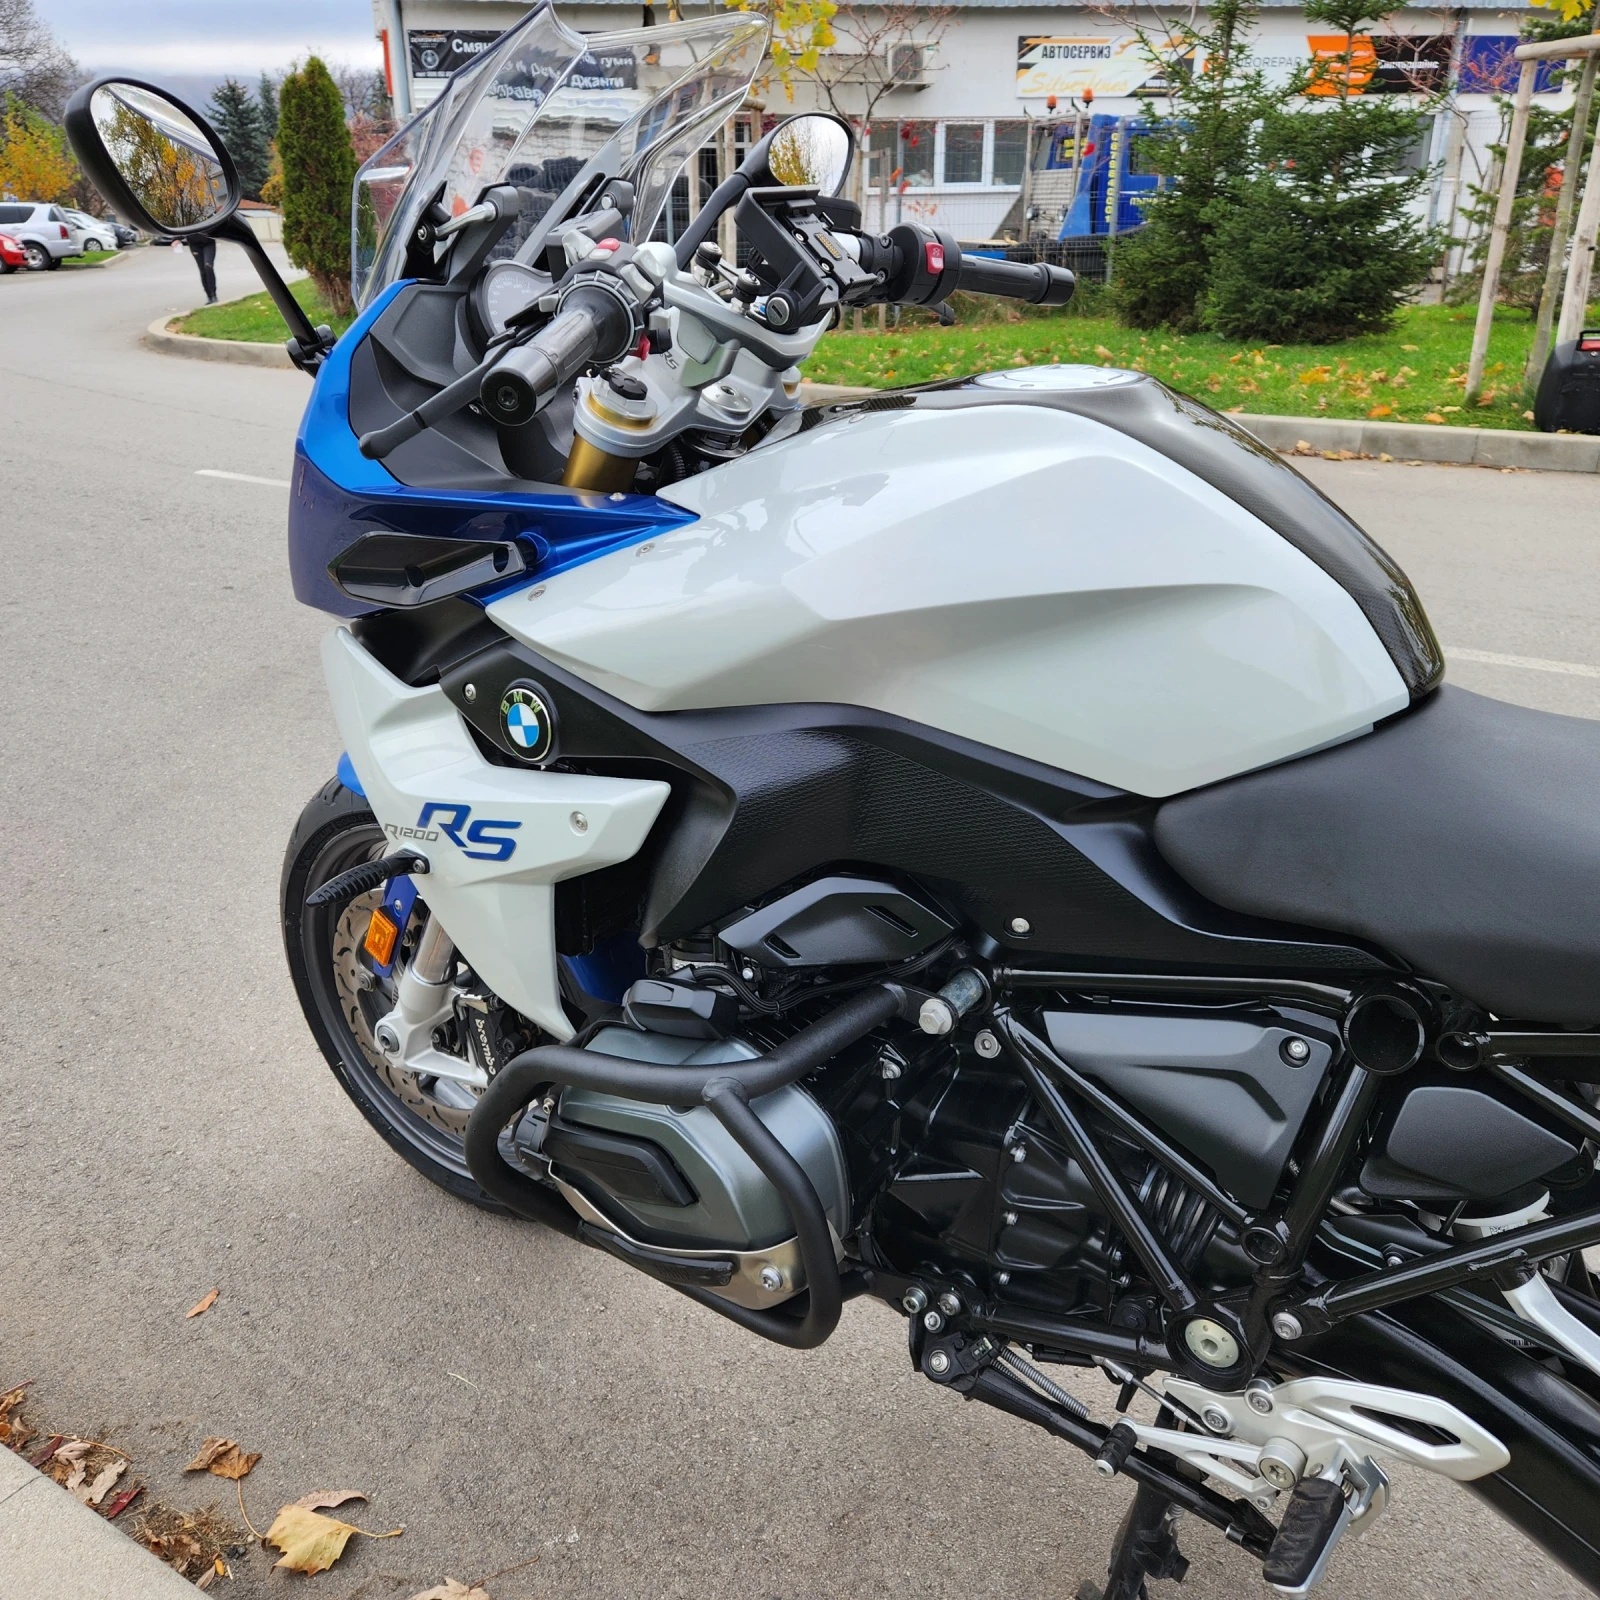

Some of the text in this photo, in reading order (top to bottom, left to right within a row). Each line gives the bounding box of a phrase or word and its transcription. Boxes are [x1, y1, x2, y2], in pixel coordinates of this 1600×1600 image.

[451, 38, 492, 53] Смян
[1041, 45, 1111, 59] АВТОСЕРВИЗ
[571, 74, 624, 88] Джанти
[500, 691, 543, 716] BMW
[384, 802, 522, 862] R1200 RS
[475, 1018, 496, 1075] brembo
